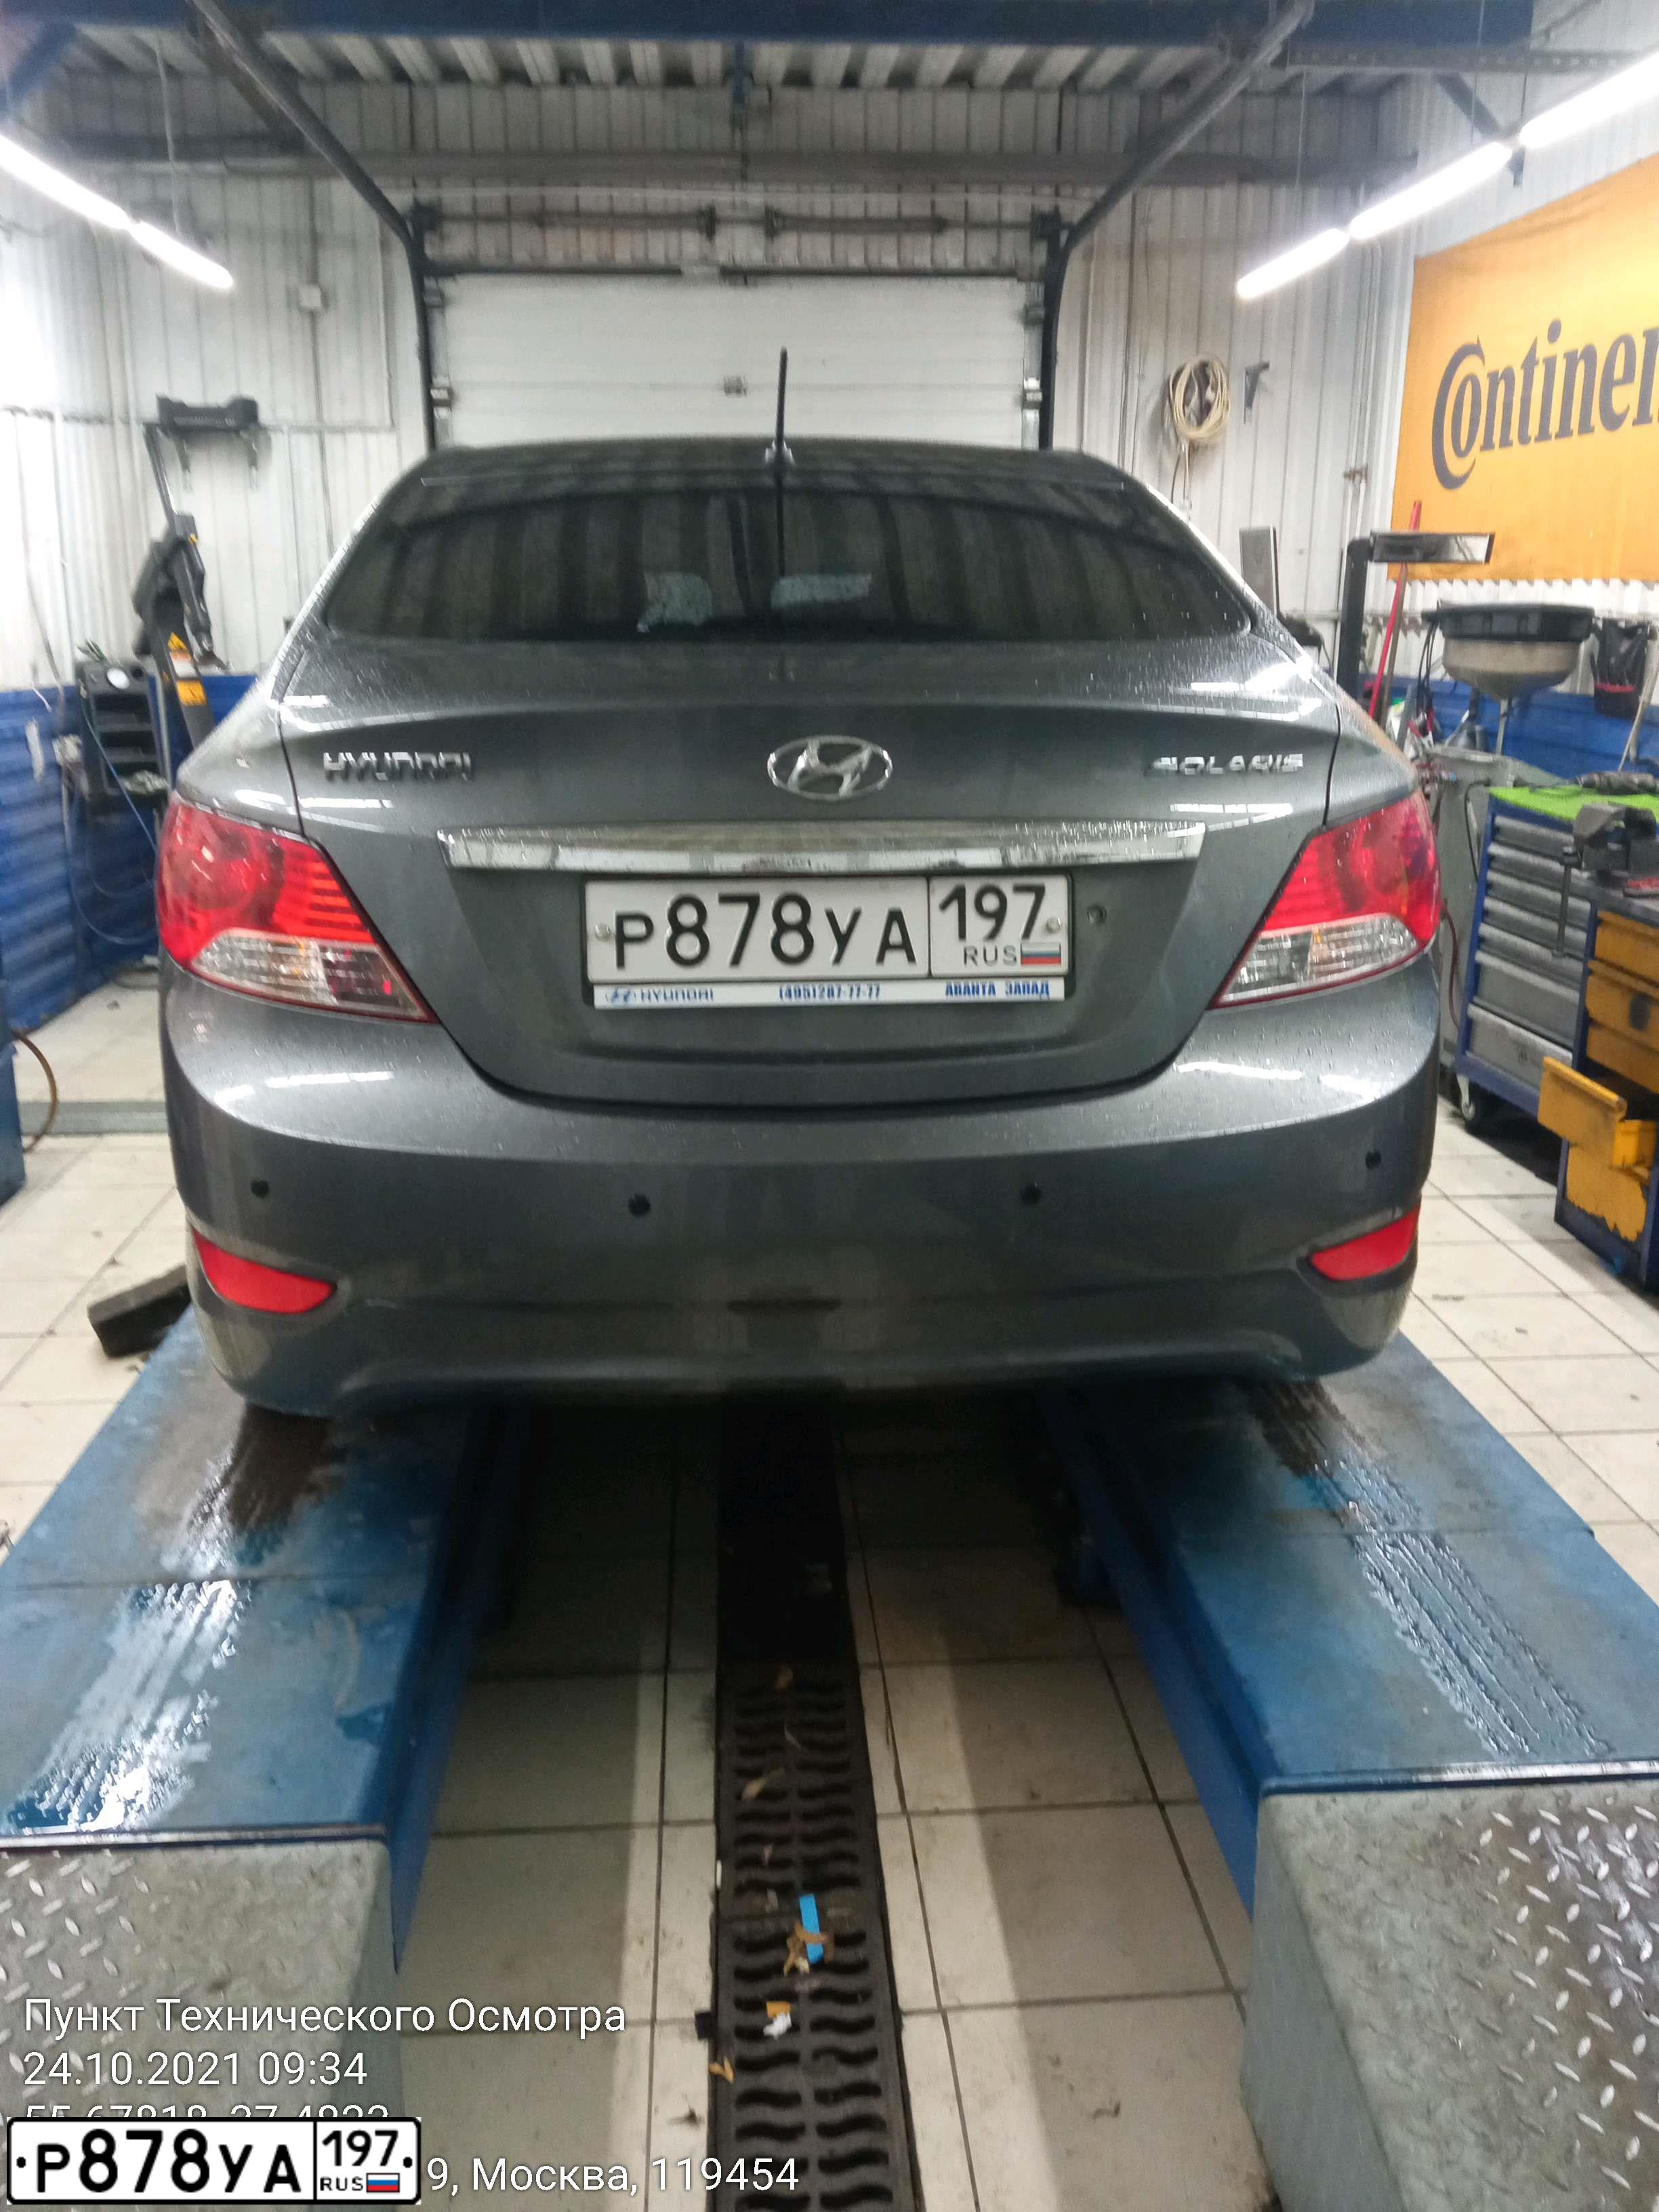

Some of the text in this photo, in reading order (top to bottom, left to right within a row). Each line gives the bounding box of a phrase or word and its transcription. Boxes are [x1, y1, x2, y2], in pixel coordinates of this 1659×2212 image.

[323, 752, 473, 782] HYUNDAI
[1145, 753, 1305, 777] SOLARIS
[938, 883, 1046, 942] 197
[963, 945, 1017, 966] RUS
